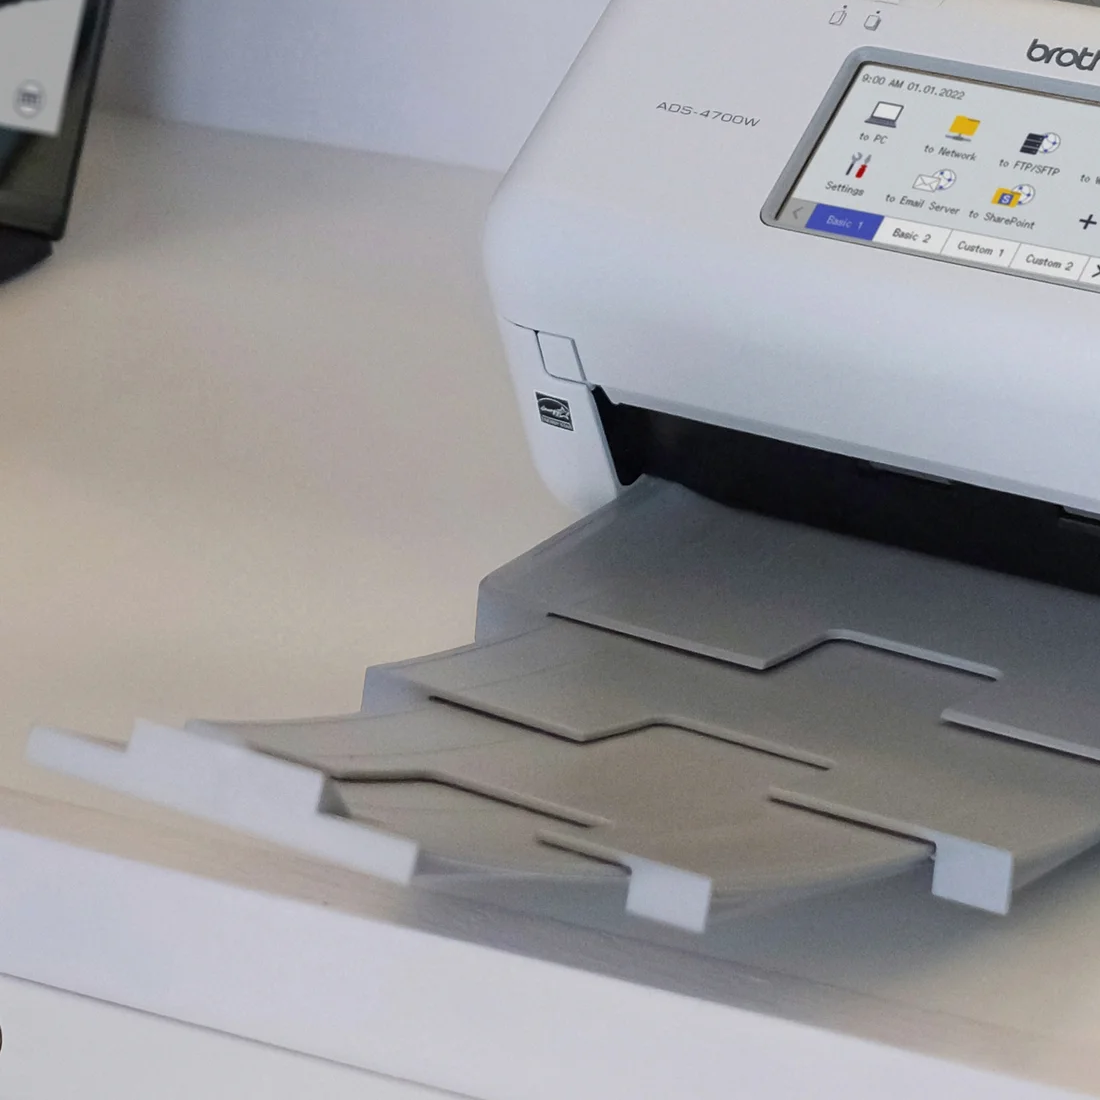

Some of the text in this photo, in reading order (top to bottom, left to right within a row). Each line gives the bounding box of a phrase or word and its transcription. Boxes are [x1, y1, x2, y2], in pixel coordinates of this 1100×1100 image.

[861, 73, 966, 100] 9:00 AM 01.01.2022
[656, 101, 761, 127] ADS-4700W
[859, 132, 888, 145] to PC
[924, 144, 977, 162] to Network
[999, 159, 1061, 177] to FTP/SFTP
[1080, 174, 1091, 183] to
[825, 181, 865, 197] Settings
[885, 194, 960, 215] to Email Server
[826, 214, 865, 231] Basic 1
[968, 210, 1036, 230] to SharePoint
[892, 227, 931, 243] Basic 2
[957, 240, 1005, 258] Custom 1
[1025, 254, 1074, 271] Custom 2
